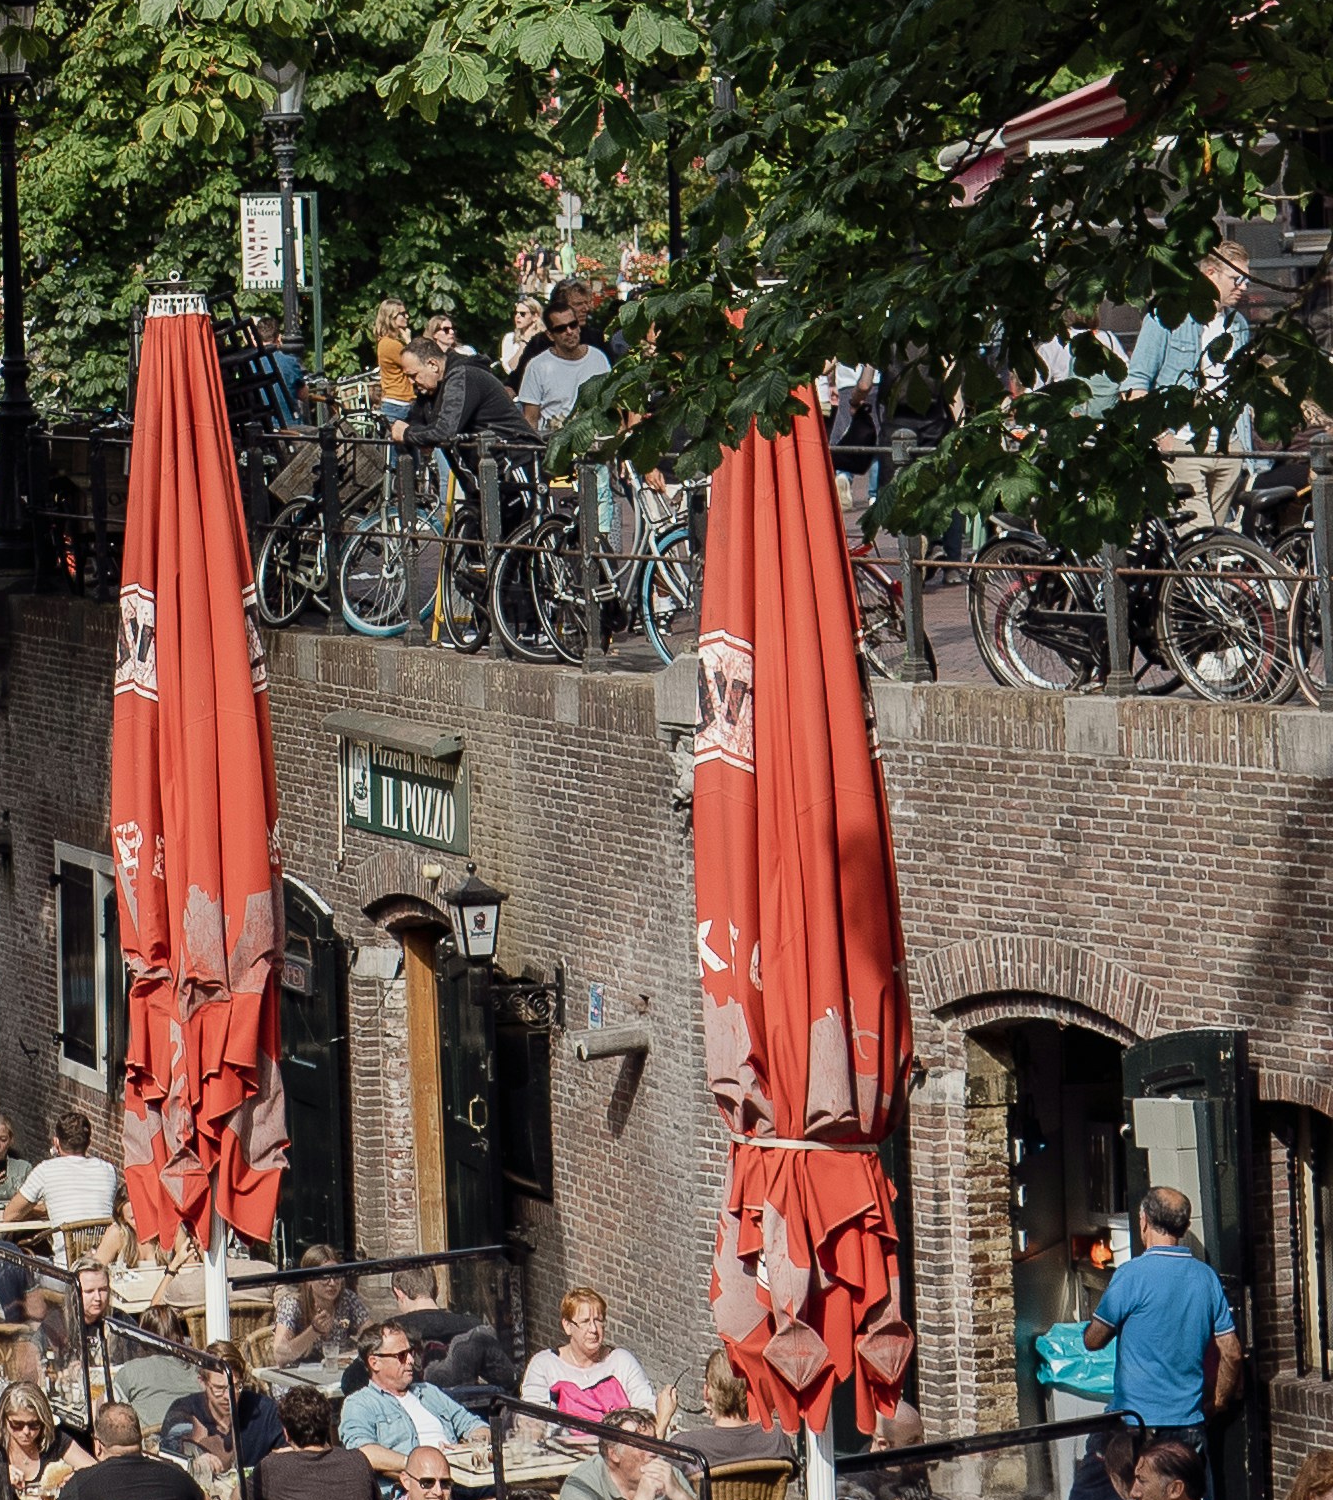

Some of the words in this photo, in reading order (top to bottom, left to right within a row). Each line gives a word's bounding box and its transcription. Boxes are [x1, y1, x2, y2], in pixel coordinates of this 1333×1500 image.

[373, 743, 412, 773] Pizzeria
[381, 775, 399, 830] IL
[401, 780, 455, 844] POZZO
